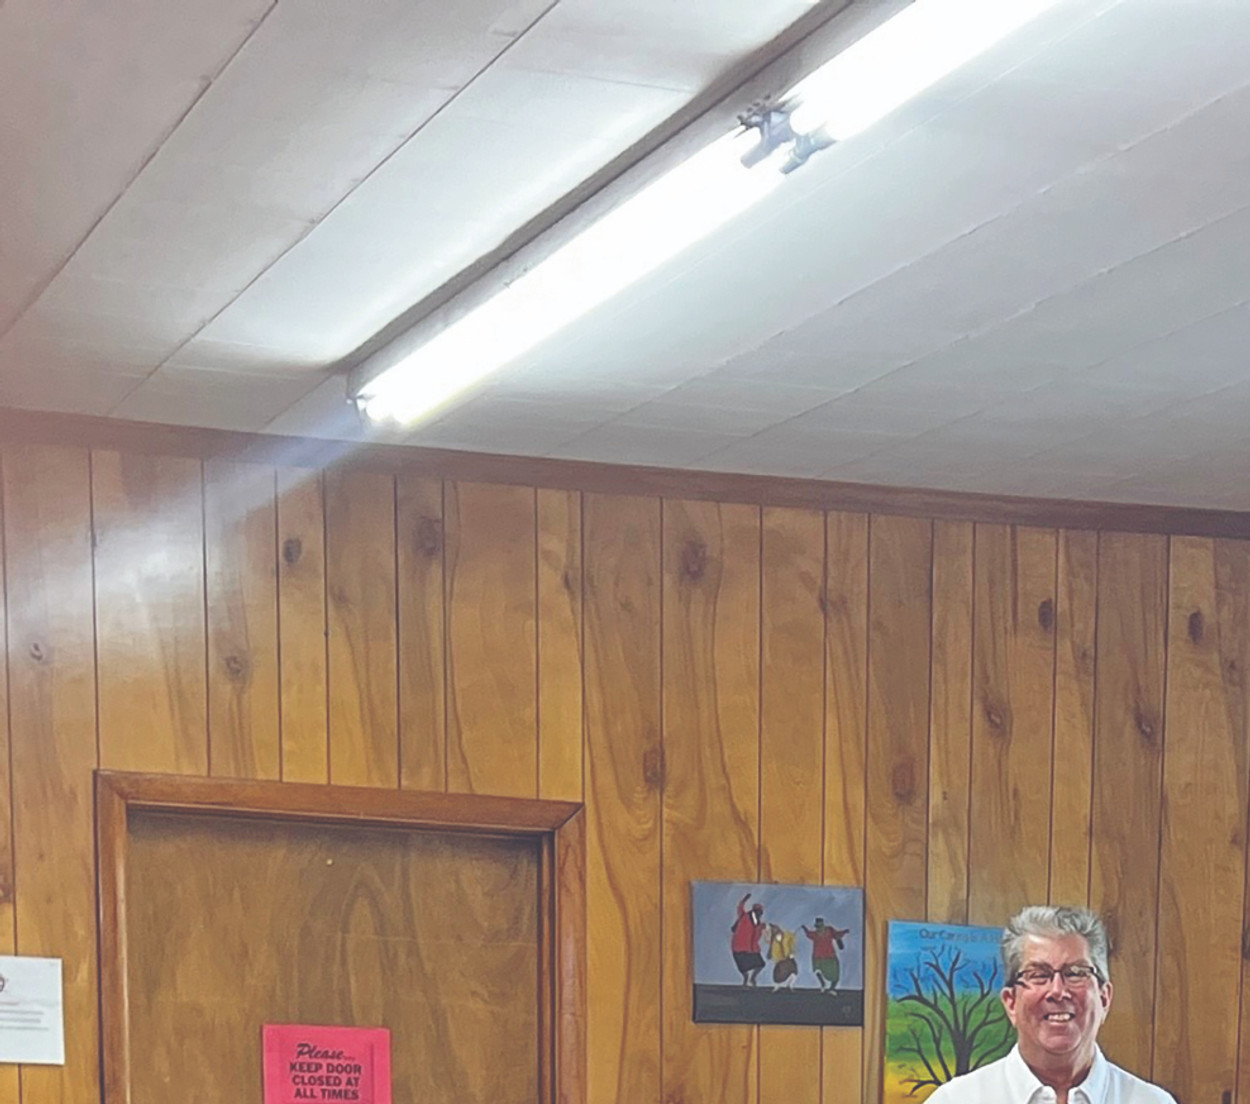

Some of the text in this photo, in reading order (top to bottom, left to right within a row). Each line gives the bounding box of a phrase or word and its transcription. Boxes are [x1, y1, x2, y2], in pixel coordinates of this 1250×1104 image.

[289, 1062, 362, 1075] KEEP DOOR
[292, 1074, 360, 1087] CLOSED AT
[294, 1088, 360, 1100] ALL TIMES
